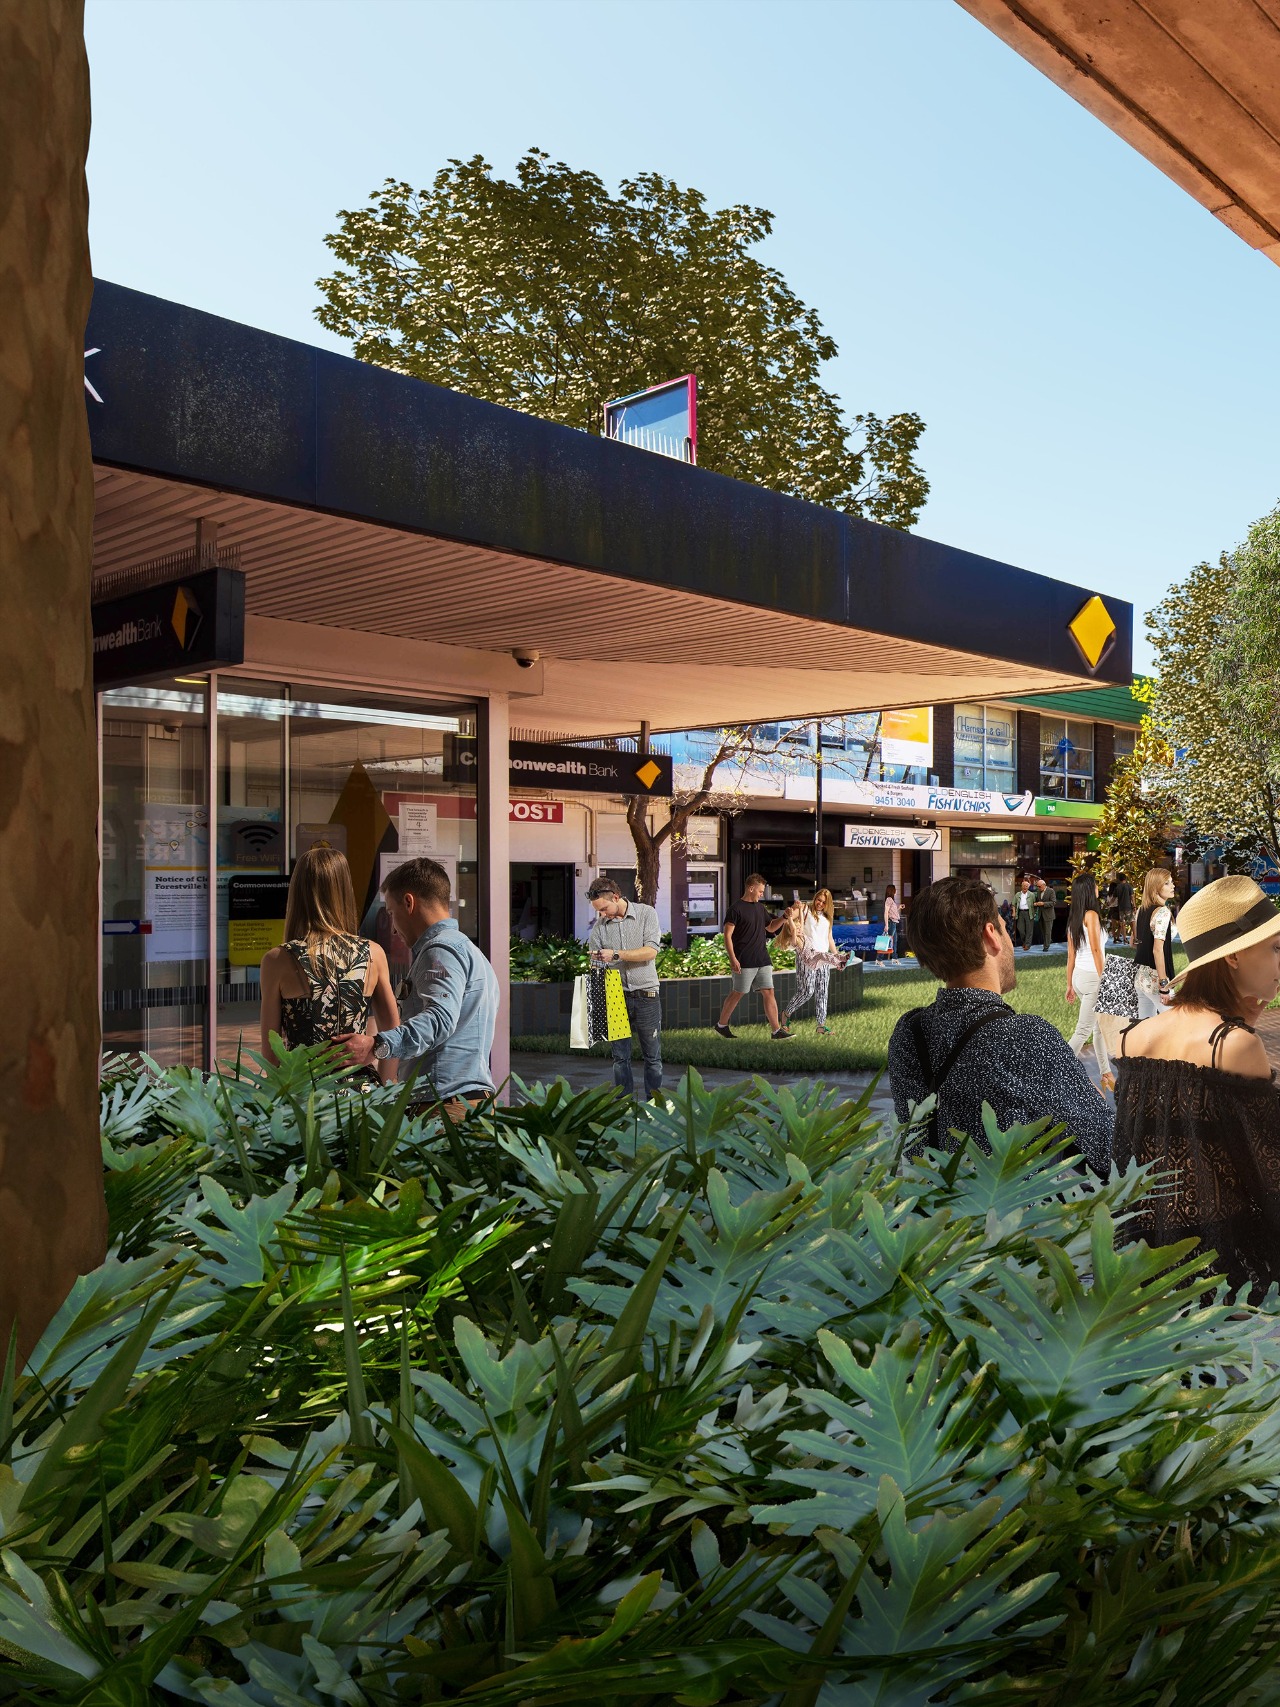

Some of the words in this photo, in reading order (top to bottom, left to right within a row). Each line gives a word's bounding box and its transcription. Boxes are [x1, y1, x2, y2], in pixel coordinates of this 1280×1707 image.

[589, 762, 619, 778] Bank
[875, 795, 894, 806] 9451
[897, 797, 916, 807] 3040
[236, 854, 257, 862] Free
[260, 854, 281, 862] WiFi
